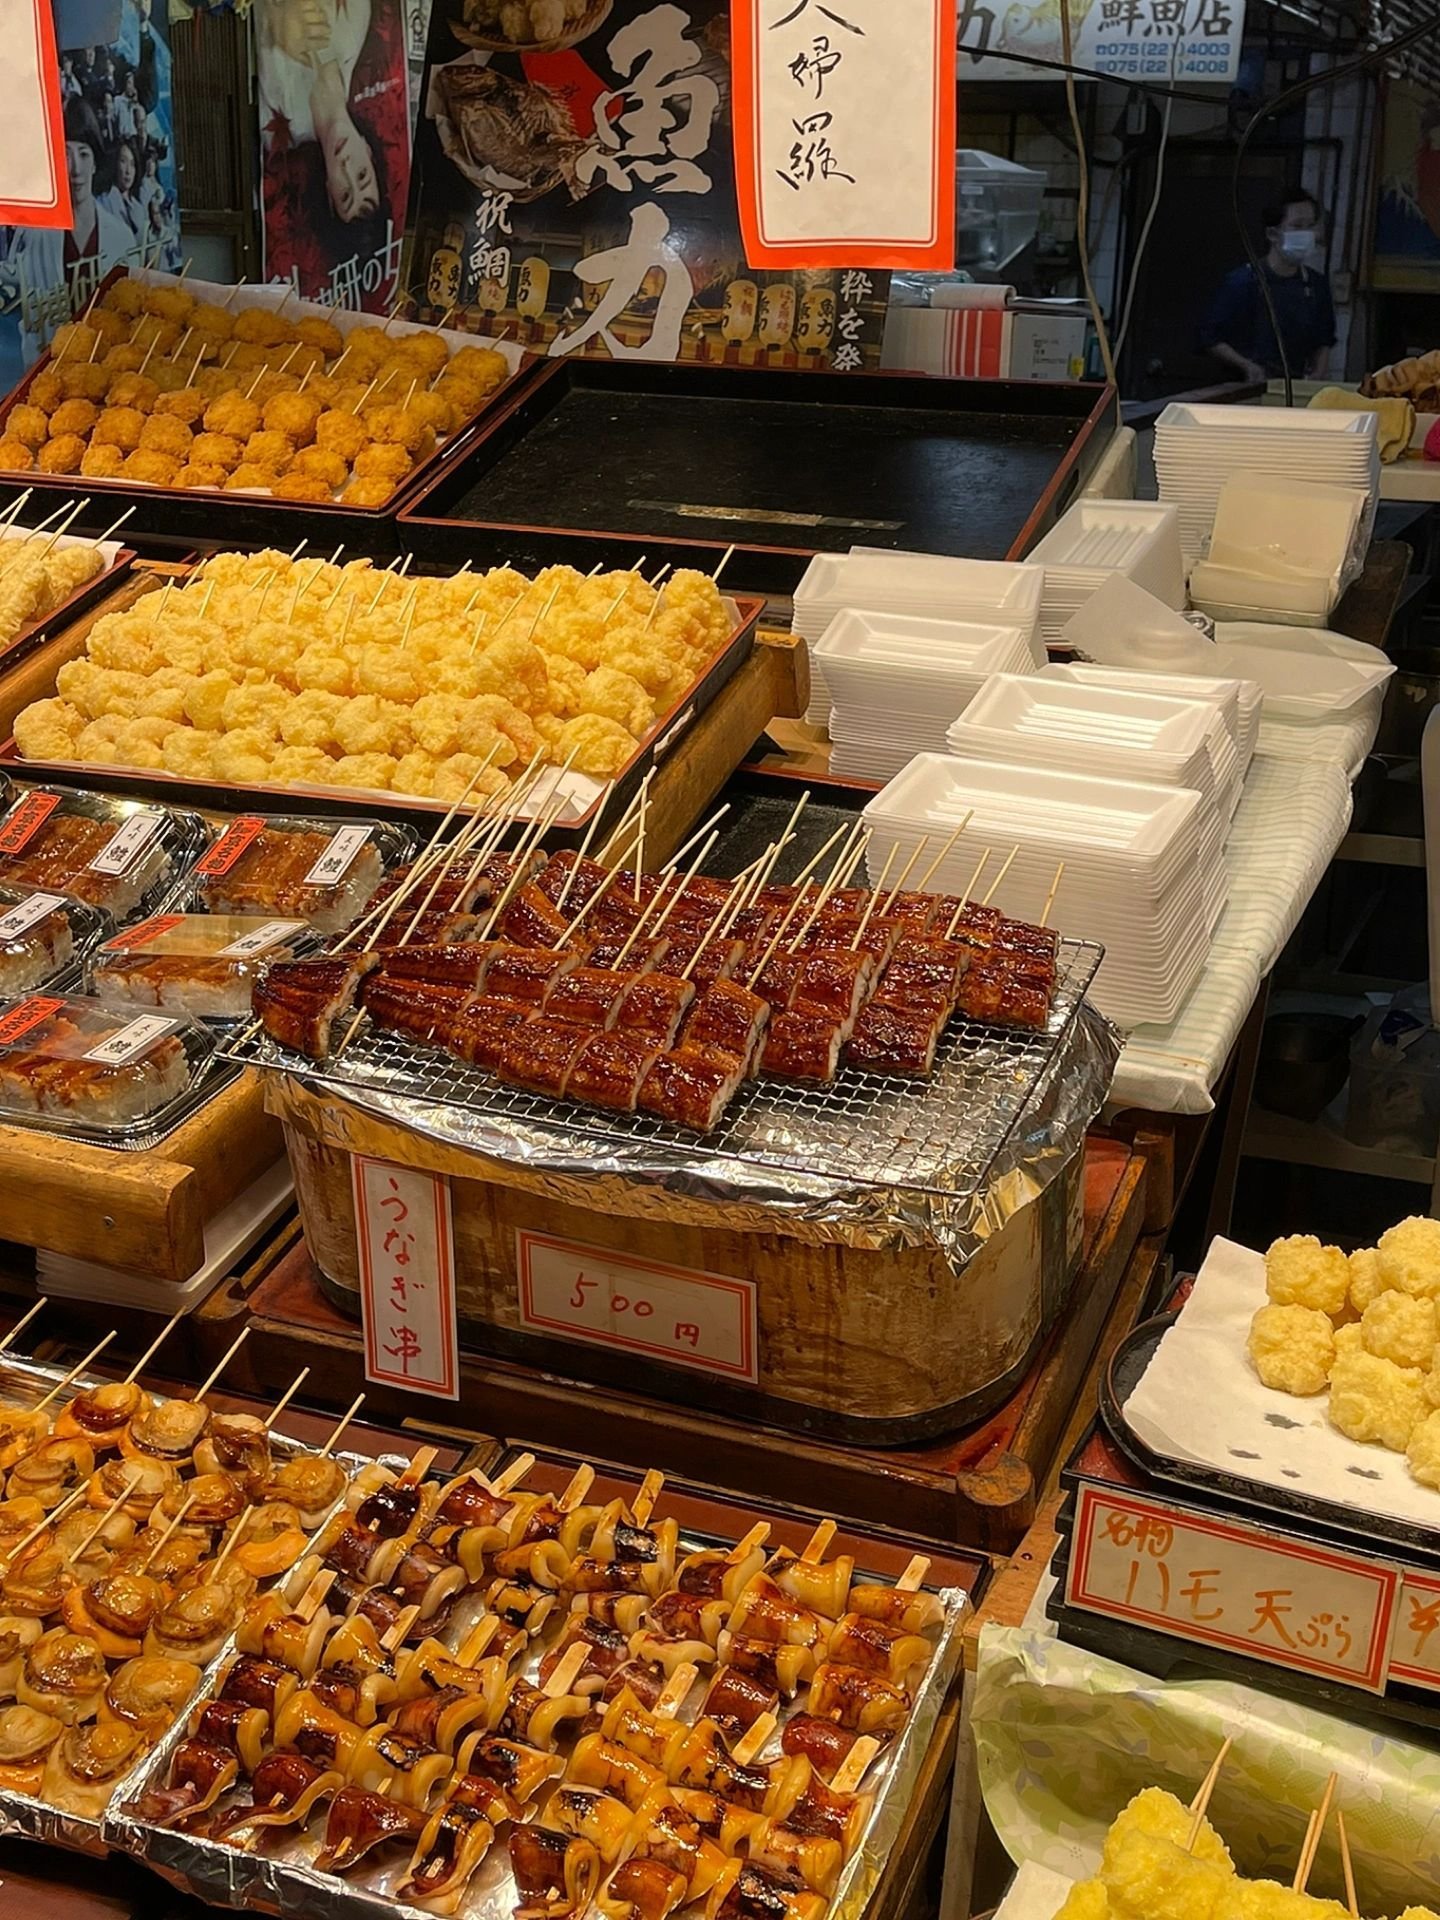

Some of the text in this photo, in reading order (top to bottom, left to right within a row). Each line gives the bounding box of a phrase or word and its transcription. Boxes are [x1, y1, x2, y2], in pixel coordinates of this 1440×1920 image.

[1106, 60, 1229, 74] 075(22)4008
[1107, 42, 1231, 56] 075(22)4003
[467, 189, 514, 288] 祝鯛
[380, 1177, 425, 1374] うなぎ串
